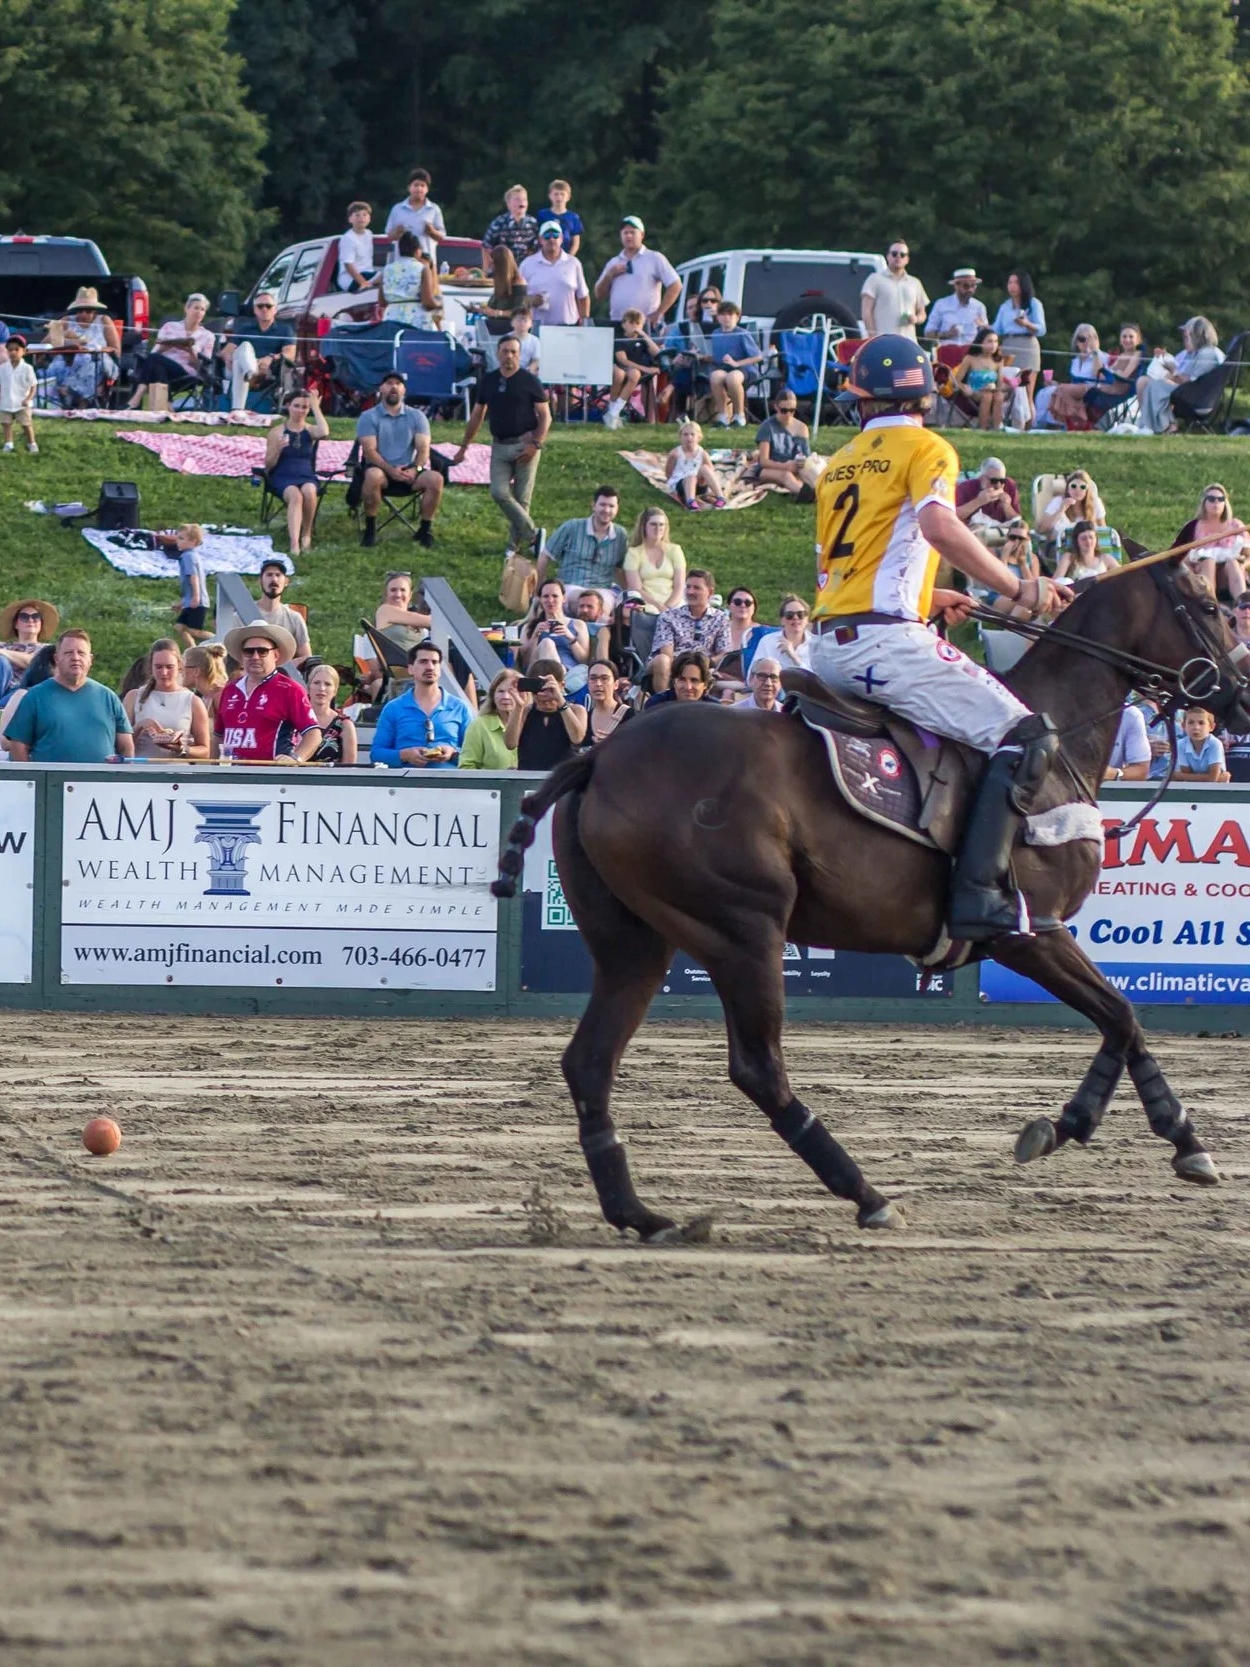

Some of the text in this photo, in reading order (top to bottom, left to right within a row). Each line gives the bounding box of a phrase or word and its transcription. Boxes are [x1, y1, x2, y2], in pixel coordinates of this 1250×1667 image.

[860, 460, 891, 474] PRO
[828, 483, 860, 560] 2
[224, 728, 257, 749] USA
[76, 797, 488, 855] AMJ FINANCIAL
[77, 859, 474, 886] WEALTH MANAGEMENT
[1092, 881, 1176, 896] EATING
[1184, 883, 1198, 896] &
[79, 899, 484, 916] WEALTH MANAGEMENT MADE SIMPLE
[1090, 919, 1163, 944] Cool
[1173, 920, 1225, 946] All
[74, 943, 487, 969] www.amjfinancial.com 703-466-0477
[1107, 972, 1250, 992] w.climaticva
